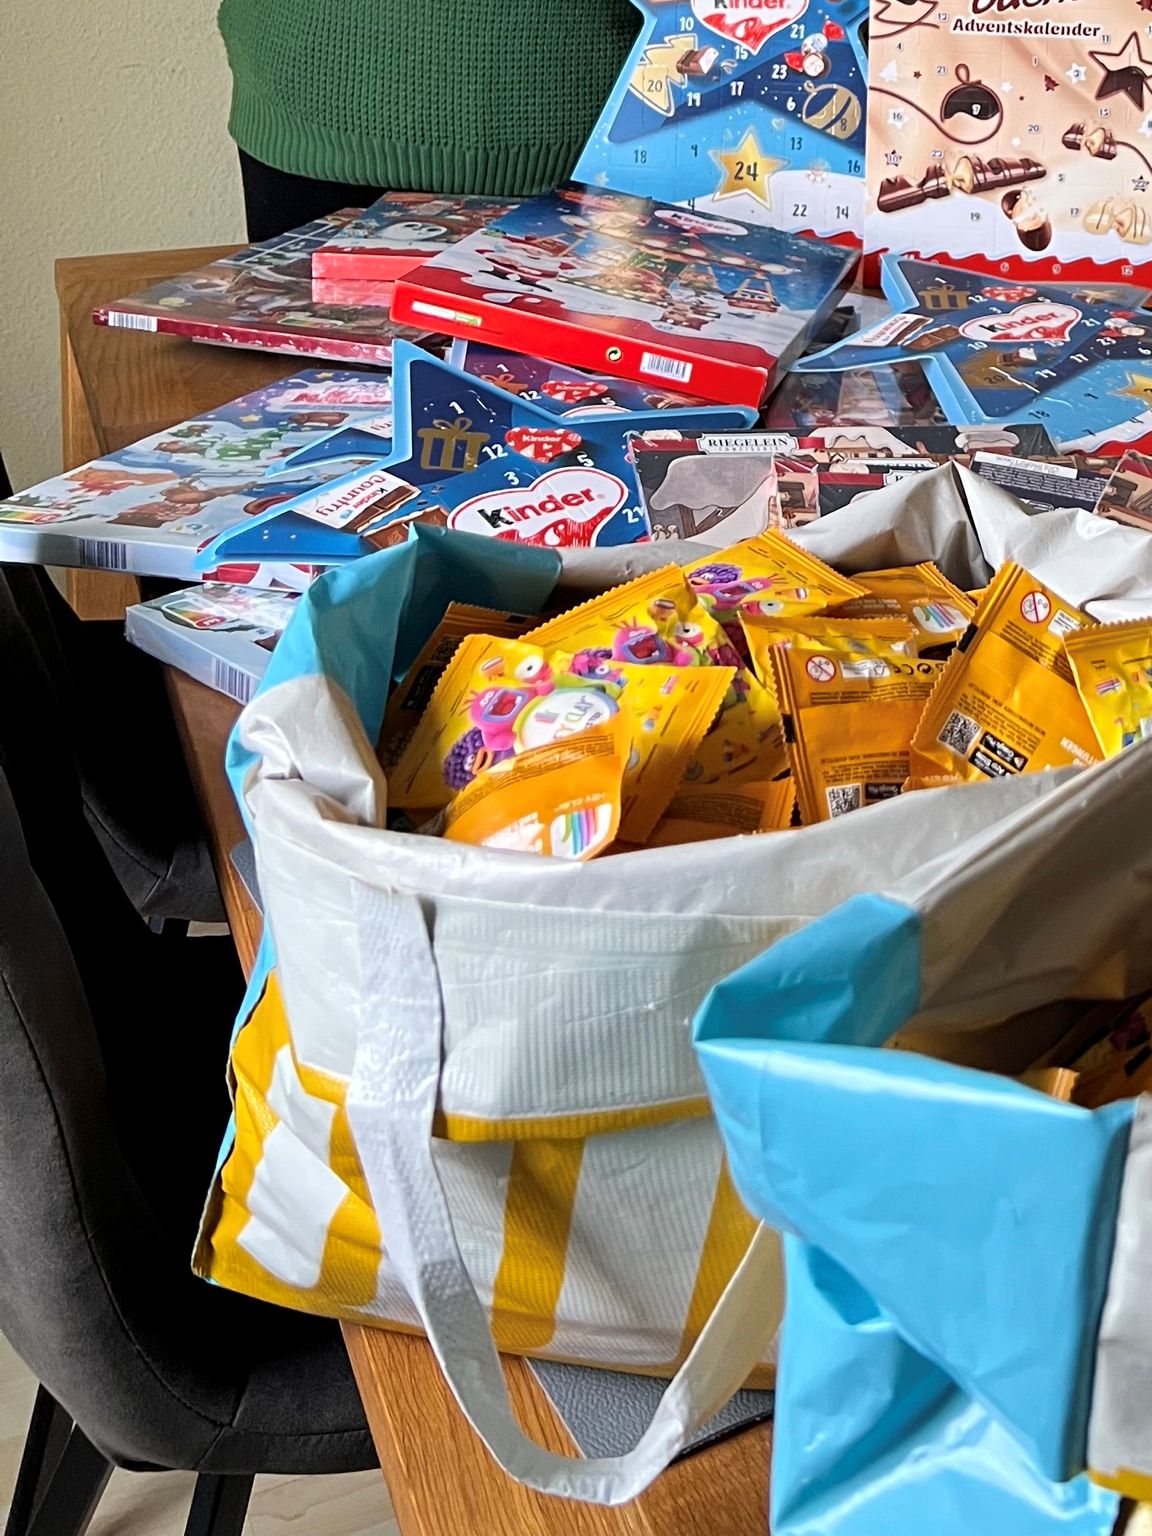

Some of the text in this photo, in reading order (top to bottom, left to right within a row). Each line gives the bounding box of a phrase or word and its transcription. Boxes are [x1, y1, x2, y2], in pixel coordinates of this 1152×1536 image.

[679, 17, 694, 31] 10
[790, 24, 805, 39] 21
[952, 18, 1101, 37] Adventskalender
[734, 45, 749, 60] 15
[772, 64, 787, 80] 23
[647, 79, 664, 93] 20
[730, 81, 744, 96] 17
[687, 92, 701, 107] 19
[786, 97, 796, 111] 6
[840, 117, 847, 132] 8
[790, 136, 803, 150] 13
[634, 150, 647, 164] 18
[733, 161, 759, 182] 24
[847, 159, 861, 173] 16
[792, 204, 807, 217] 22
[836, 205, 849, 219] 14
[520, 390, 542, 401] 12
[449, 401, 464, 415] 1
[708, 438, 788, 447] RIEGELEIN
[481, 444, 509, 461] 12
[577, 453, 594, 468] 5
[503, 471, 519, 486] 3
[315, 474, 386, 517] Country
